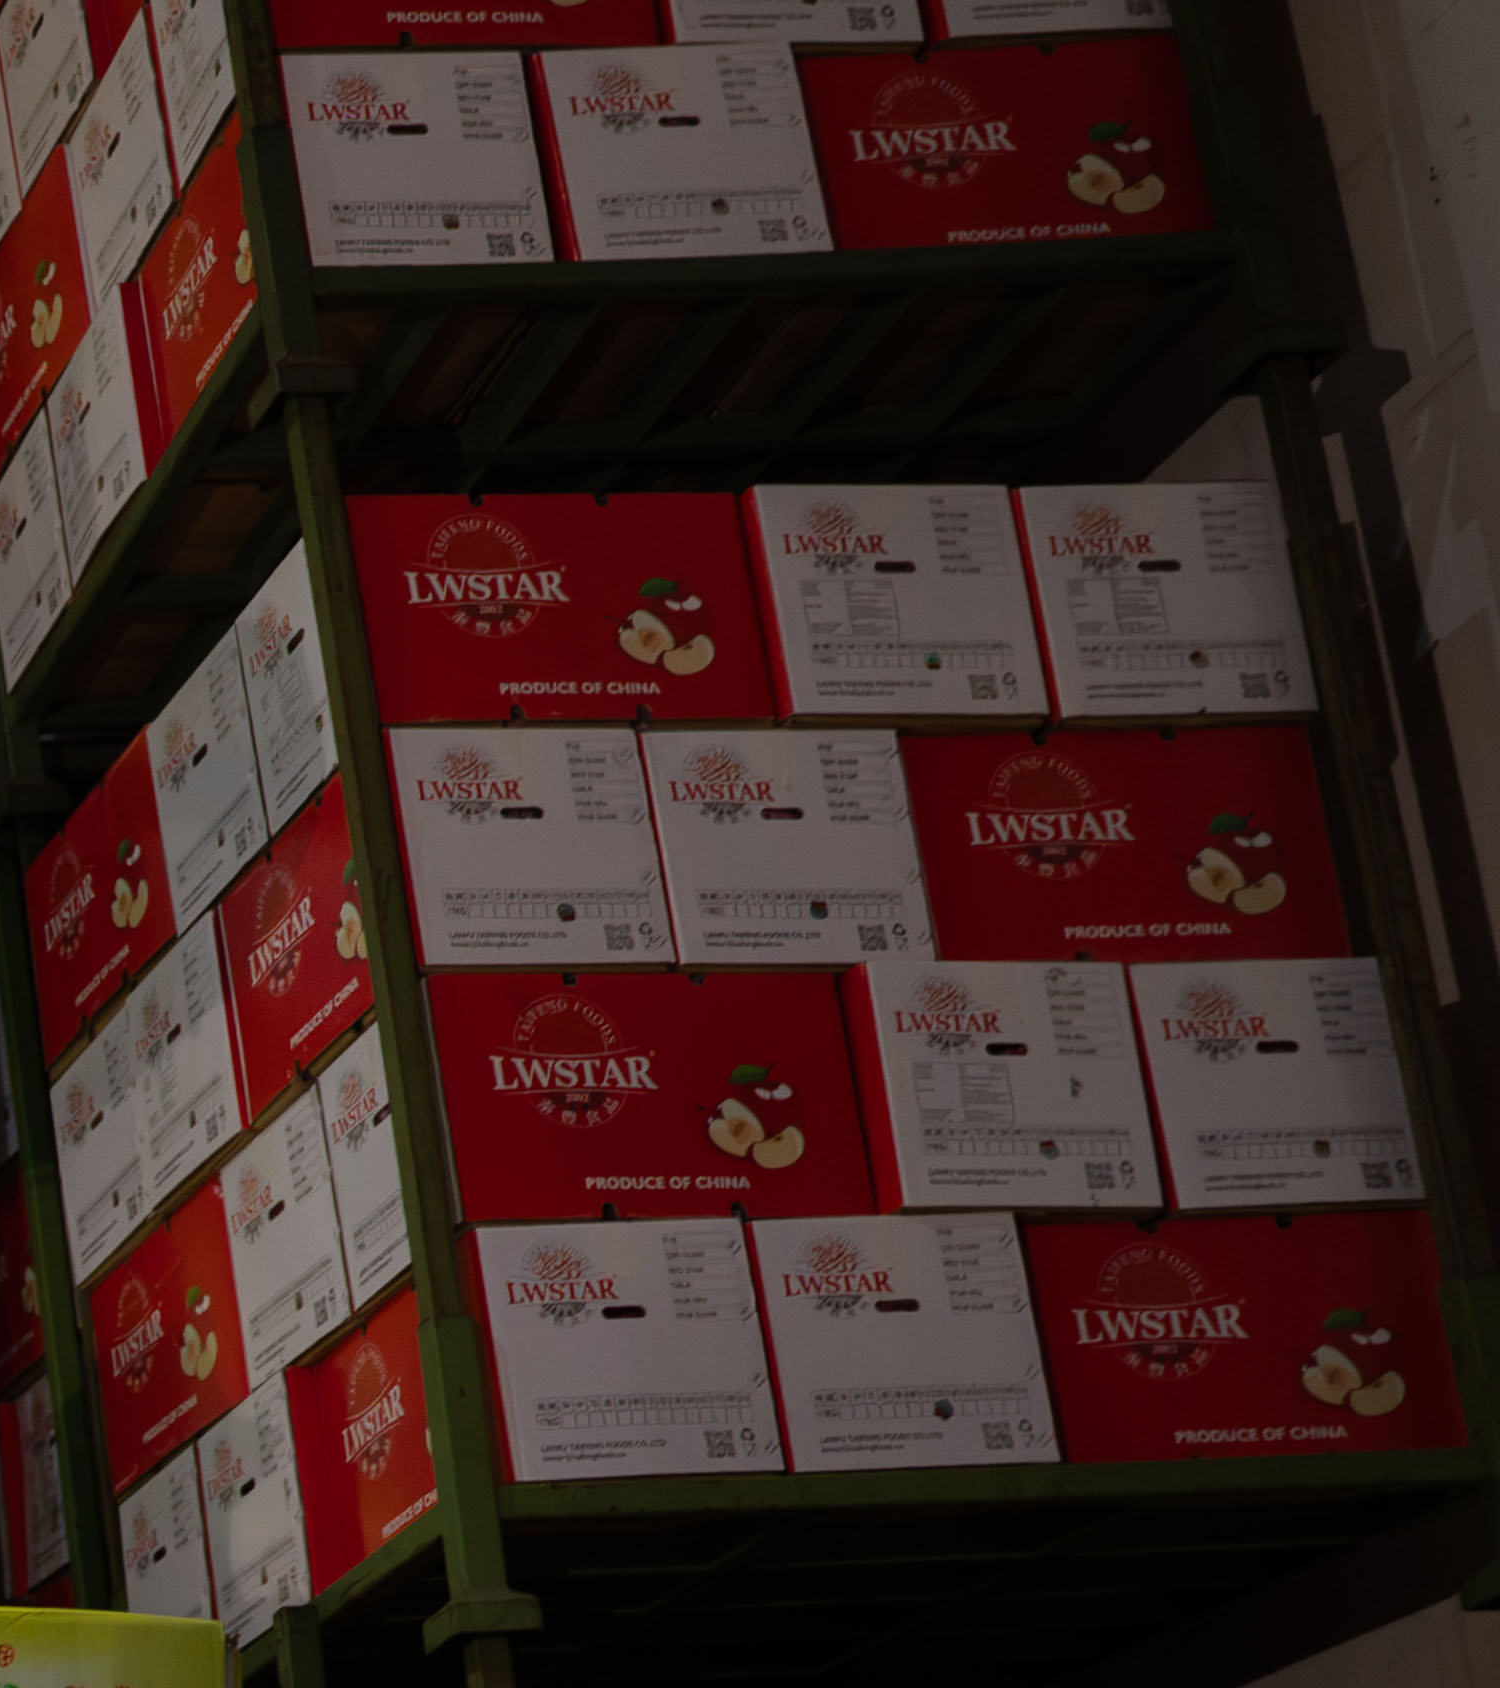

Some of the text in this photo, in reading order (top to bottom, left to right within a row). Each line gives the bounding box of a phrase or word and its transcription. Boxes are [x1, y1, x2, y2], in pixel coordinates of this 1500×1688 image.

[849, 121, 1017, 162] LWSTAR
[781, 533, 889, 558] LWSTAR
[403, 570, 570, 604] LWSTAR
[498, 679, 661, 696] PRODUCE OF CHINA
[965, 808, 1135, 846] LWSTAR
[247, 895, 315, 988] LWSTAR
[892, 1007, 1004, 1036] LWSTAR
[1158, 1014, 1272, 1043] LWSTAR
[489, 1055, 658, 1091] LWSTAR
[584, 1175, 751, 1190] PRODUCE OF CHINA
[1072, 1304, 1248, 1345] LWSTAR
[340, 1385, 405, 1464] LWSTAR
[1173, 1425, 1349, 1444] PRODUCE OF CHINA
